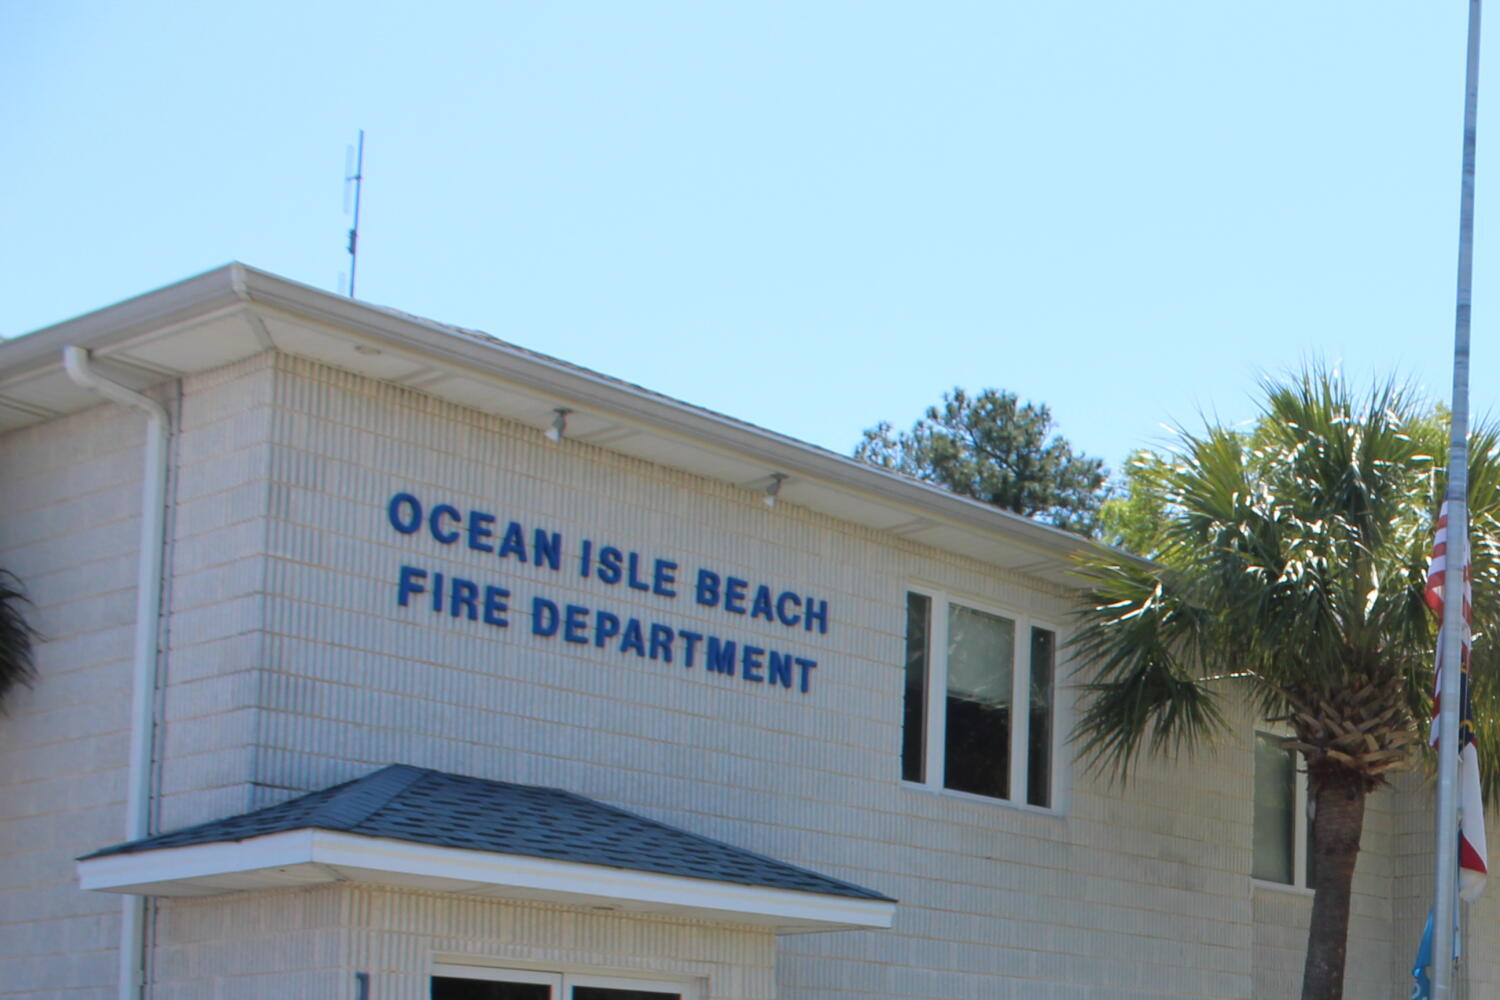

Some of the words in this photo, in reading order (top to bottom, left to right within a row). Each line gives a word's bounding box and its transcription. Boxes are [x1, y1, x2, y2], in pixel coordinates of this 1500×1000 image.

[388, 492, 562, 570] OCEAN
[580, 539, 679, 598] ISLE
[696, 568, 829, 634] BEACH
[397, 565, 511, 628] FIRE
[531, 596, 818, 694] DEPARTMENT
